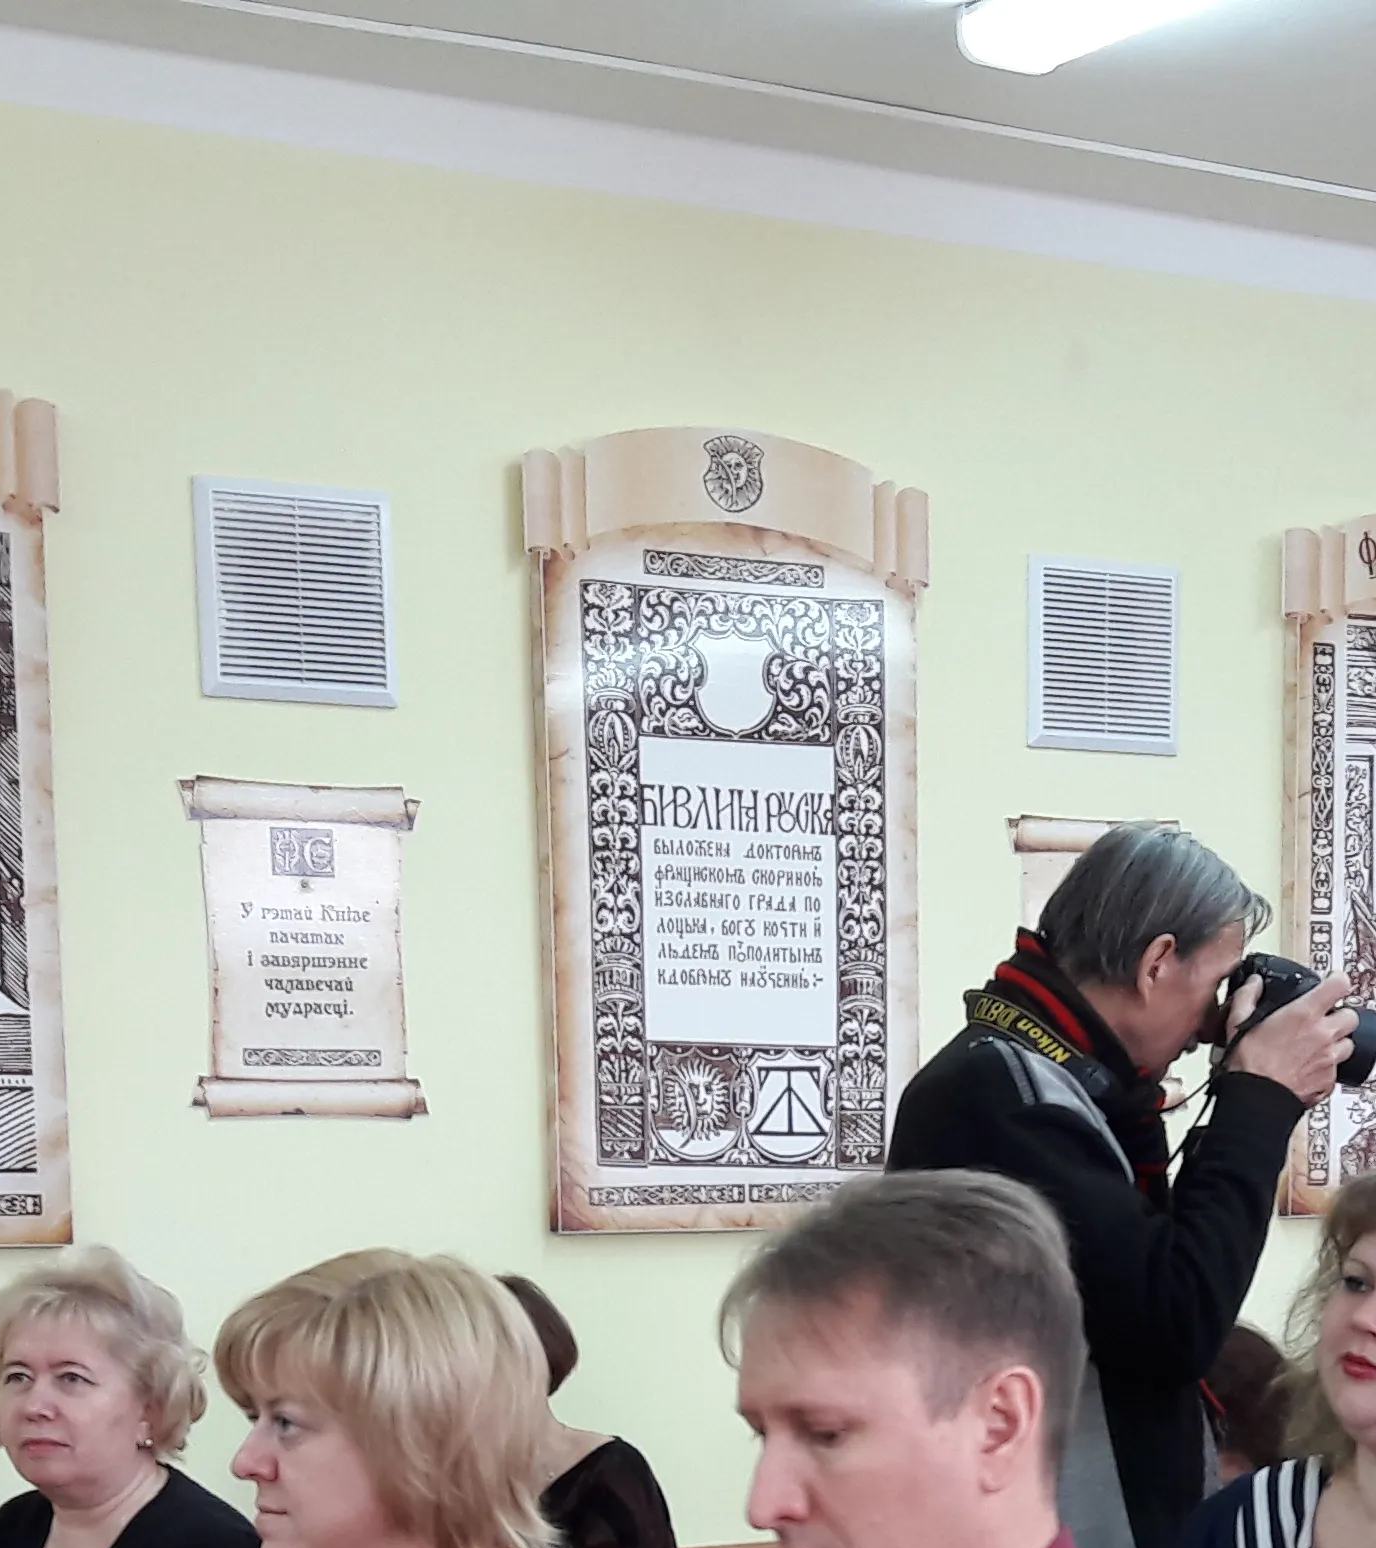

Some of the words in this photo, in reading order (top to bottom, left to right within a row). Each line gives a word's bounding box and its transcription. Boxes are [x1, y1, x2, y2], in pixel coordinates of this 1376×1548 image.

[240, 901, 253, 919] У
[261, 906, 313, 921] гэтай
[320, 904, 371, 923] Кнізе
[269, 931, 345, 945] пачатак
[260, 954, 368, 972] завяршэнне
[264, 976, 354, 995] чалавечай
[265, 998, 354, 1019] мудрасці.
[1016, 1018, 1072, 1063] Nikon
